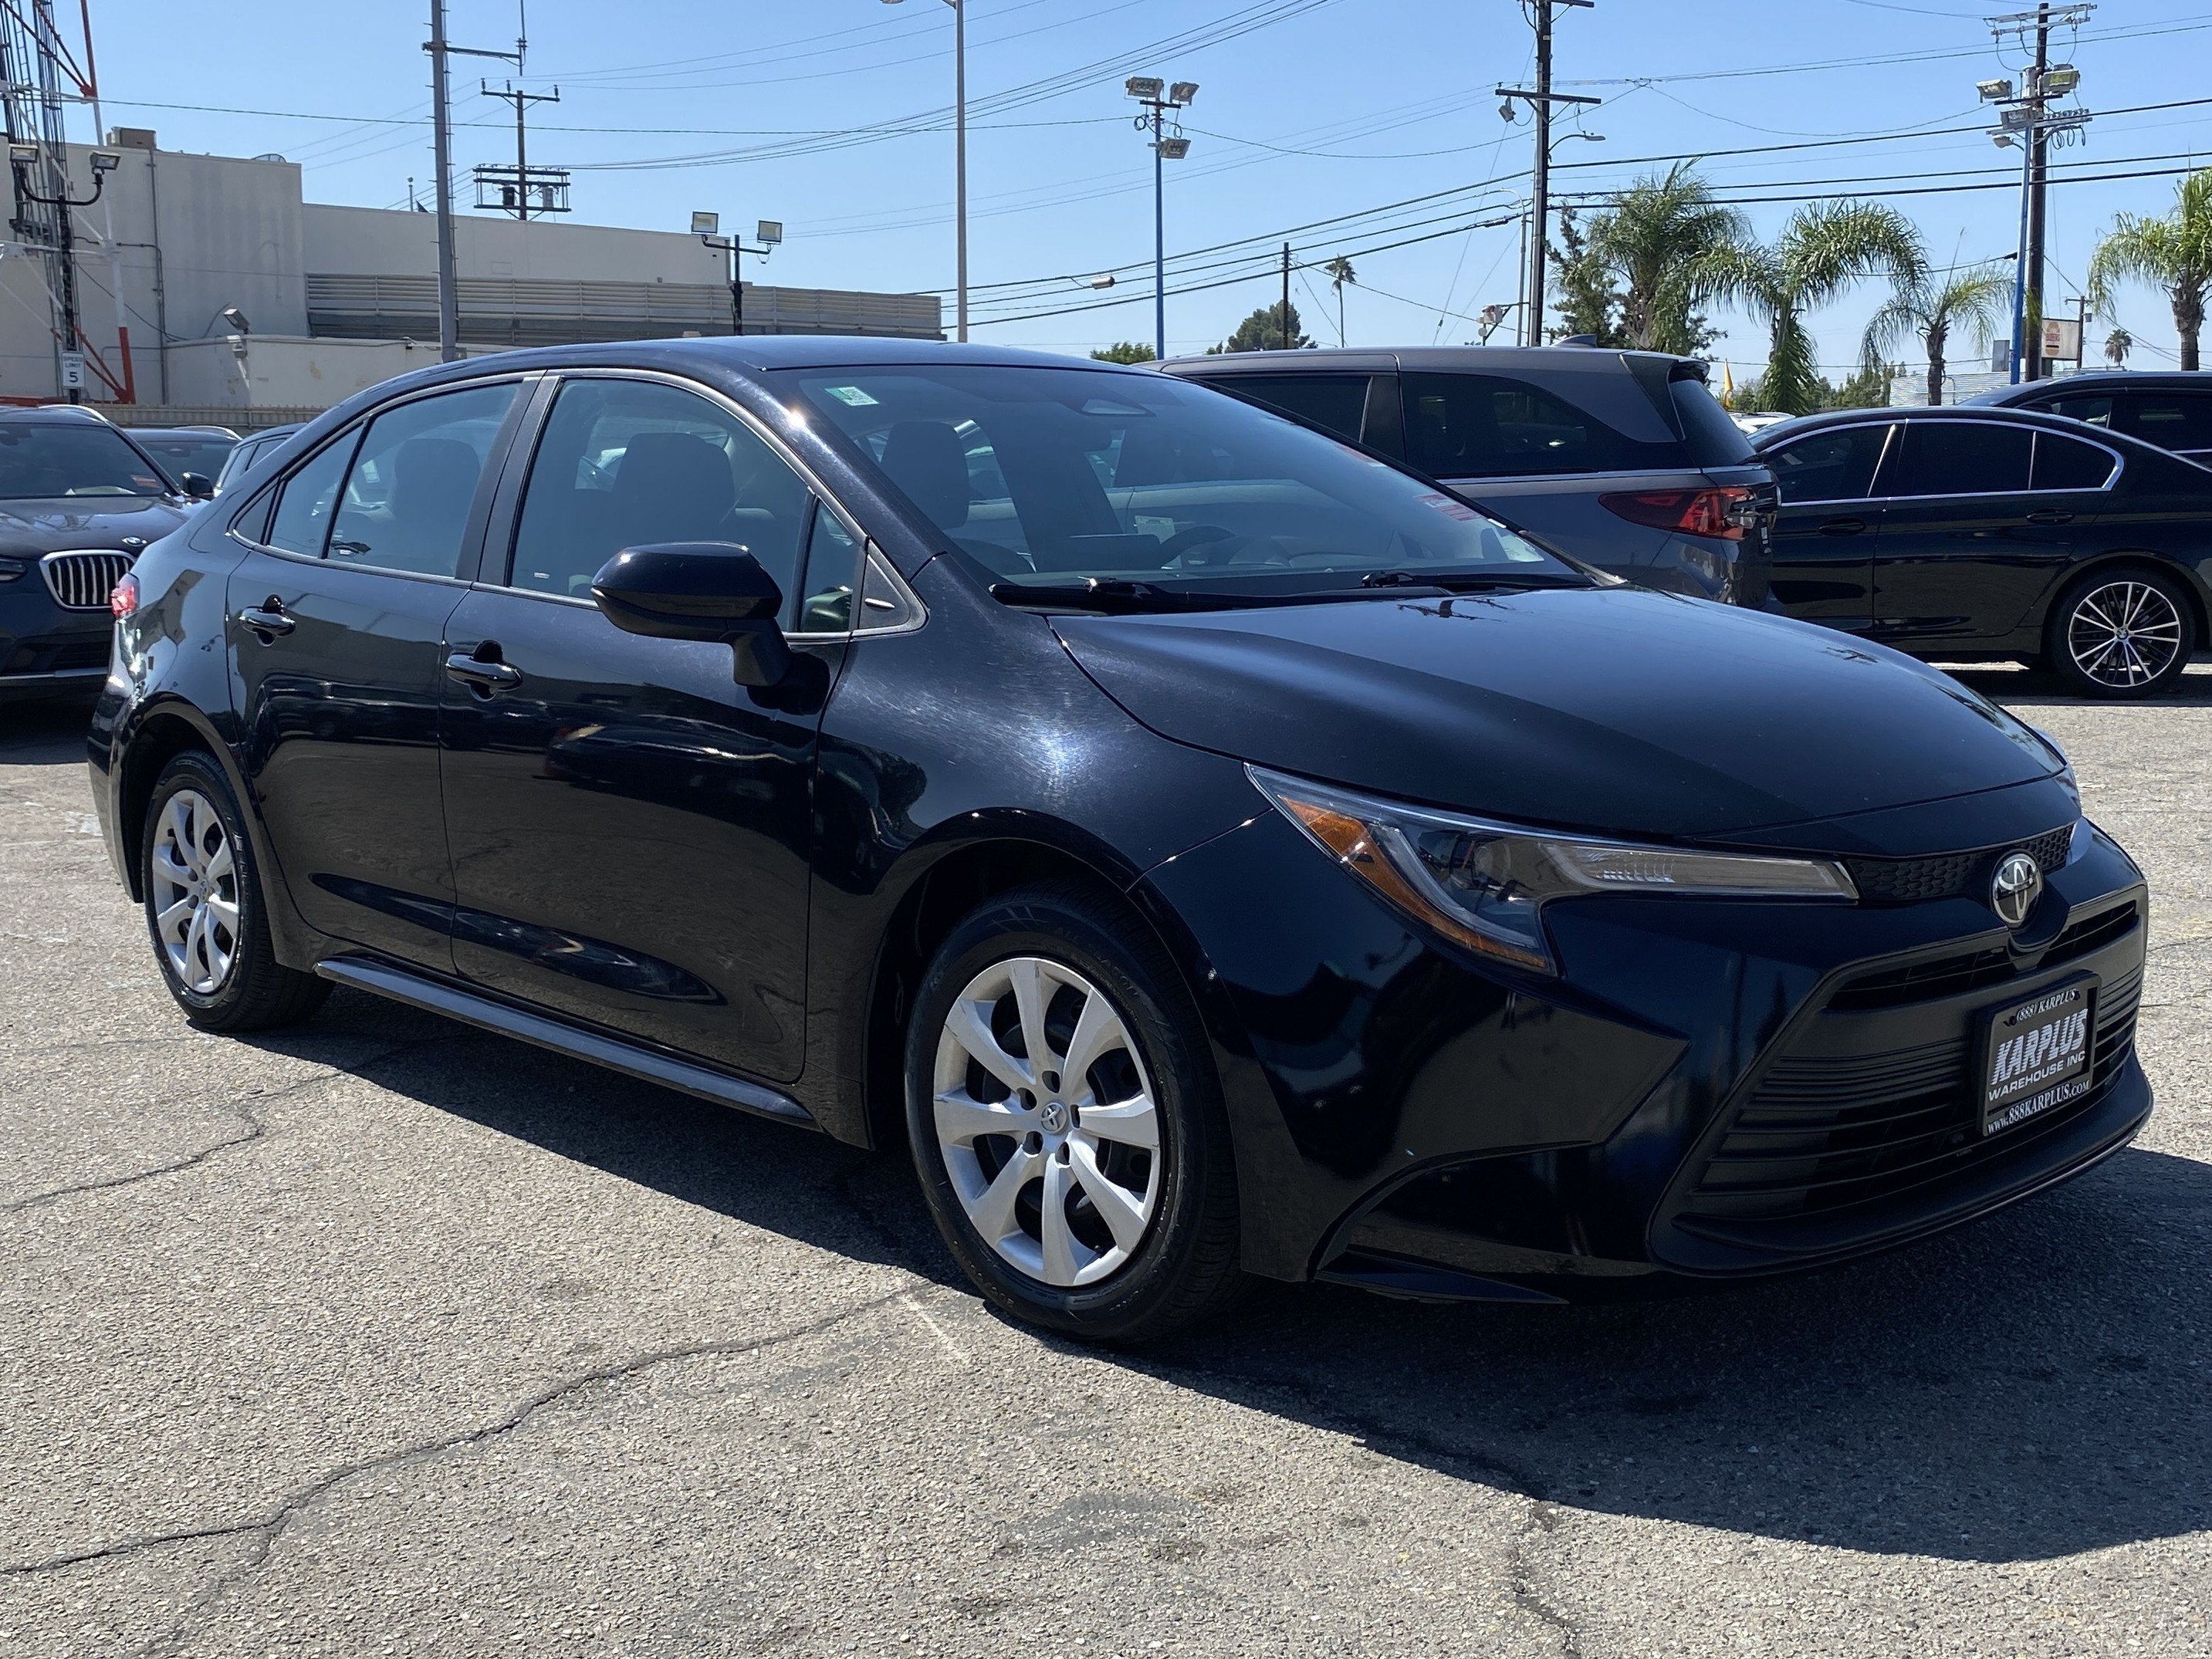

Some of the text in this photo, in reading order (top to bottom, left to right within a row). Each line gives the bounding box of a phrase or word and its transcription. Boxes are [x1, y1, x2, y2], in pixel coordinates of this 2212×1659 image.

[69, 371, 78, 383] 5
[2016, 988, 2076, 1023] (888) KARPLUS
[1990, 1008, 2089, 1086] KARPLUS
[1988, 1050, 2086, 1102] WAREHOUSE INC
